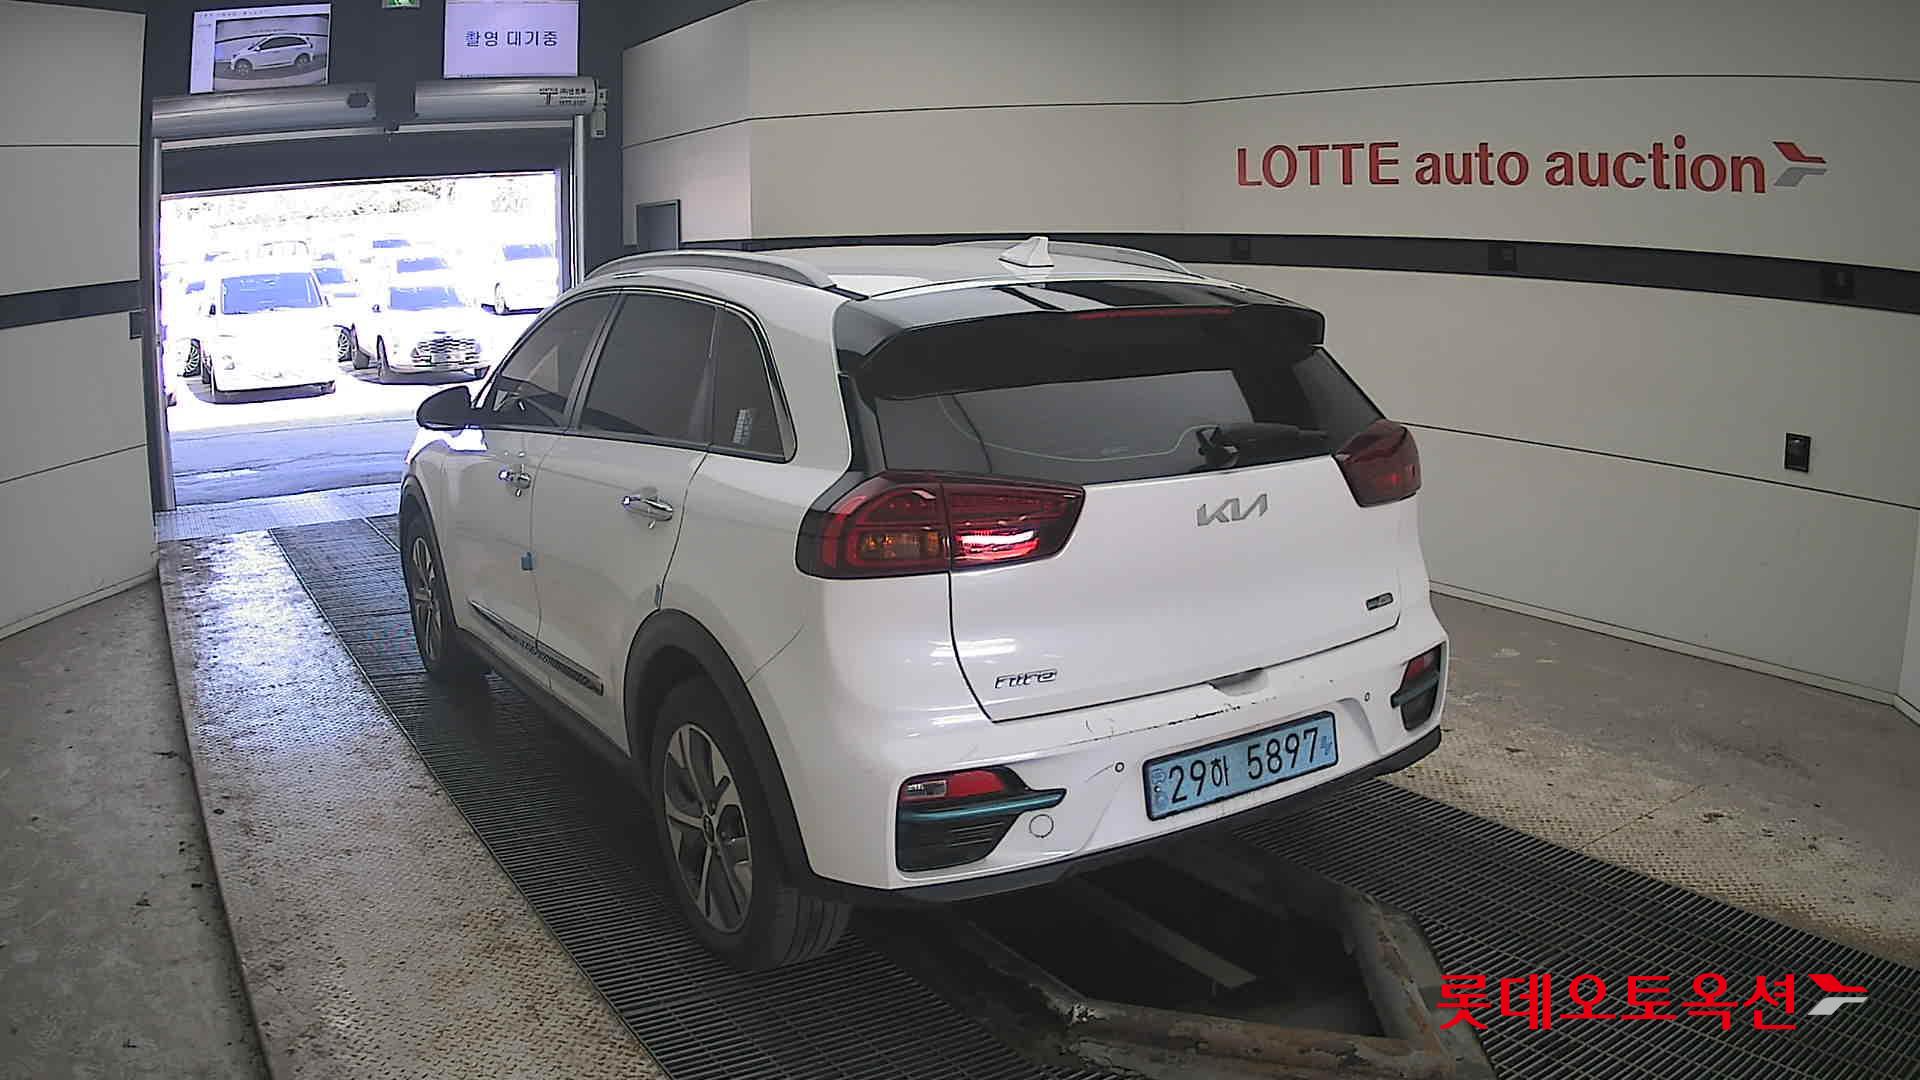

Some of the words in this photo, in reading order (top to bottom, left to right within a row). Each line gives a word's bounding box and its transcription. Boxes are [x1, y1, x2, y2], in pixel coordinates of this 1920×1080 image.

[507, 31, 557, 47] 대기중
[1237, 142, 1400, 189] LOTTE
[1415, 142, 1529, 186] auto
[1545, 134, 1766, 194] auction
[1168, 755, 1230, 804] 29하
[1247, 727, 1318, 780] 5897
